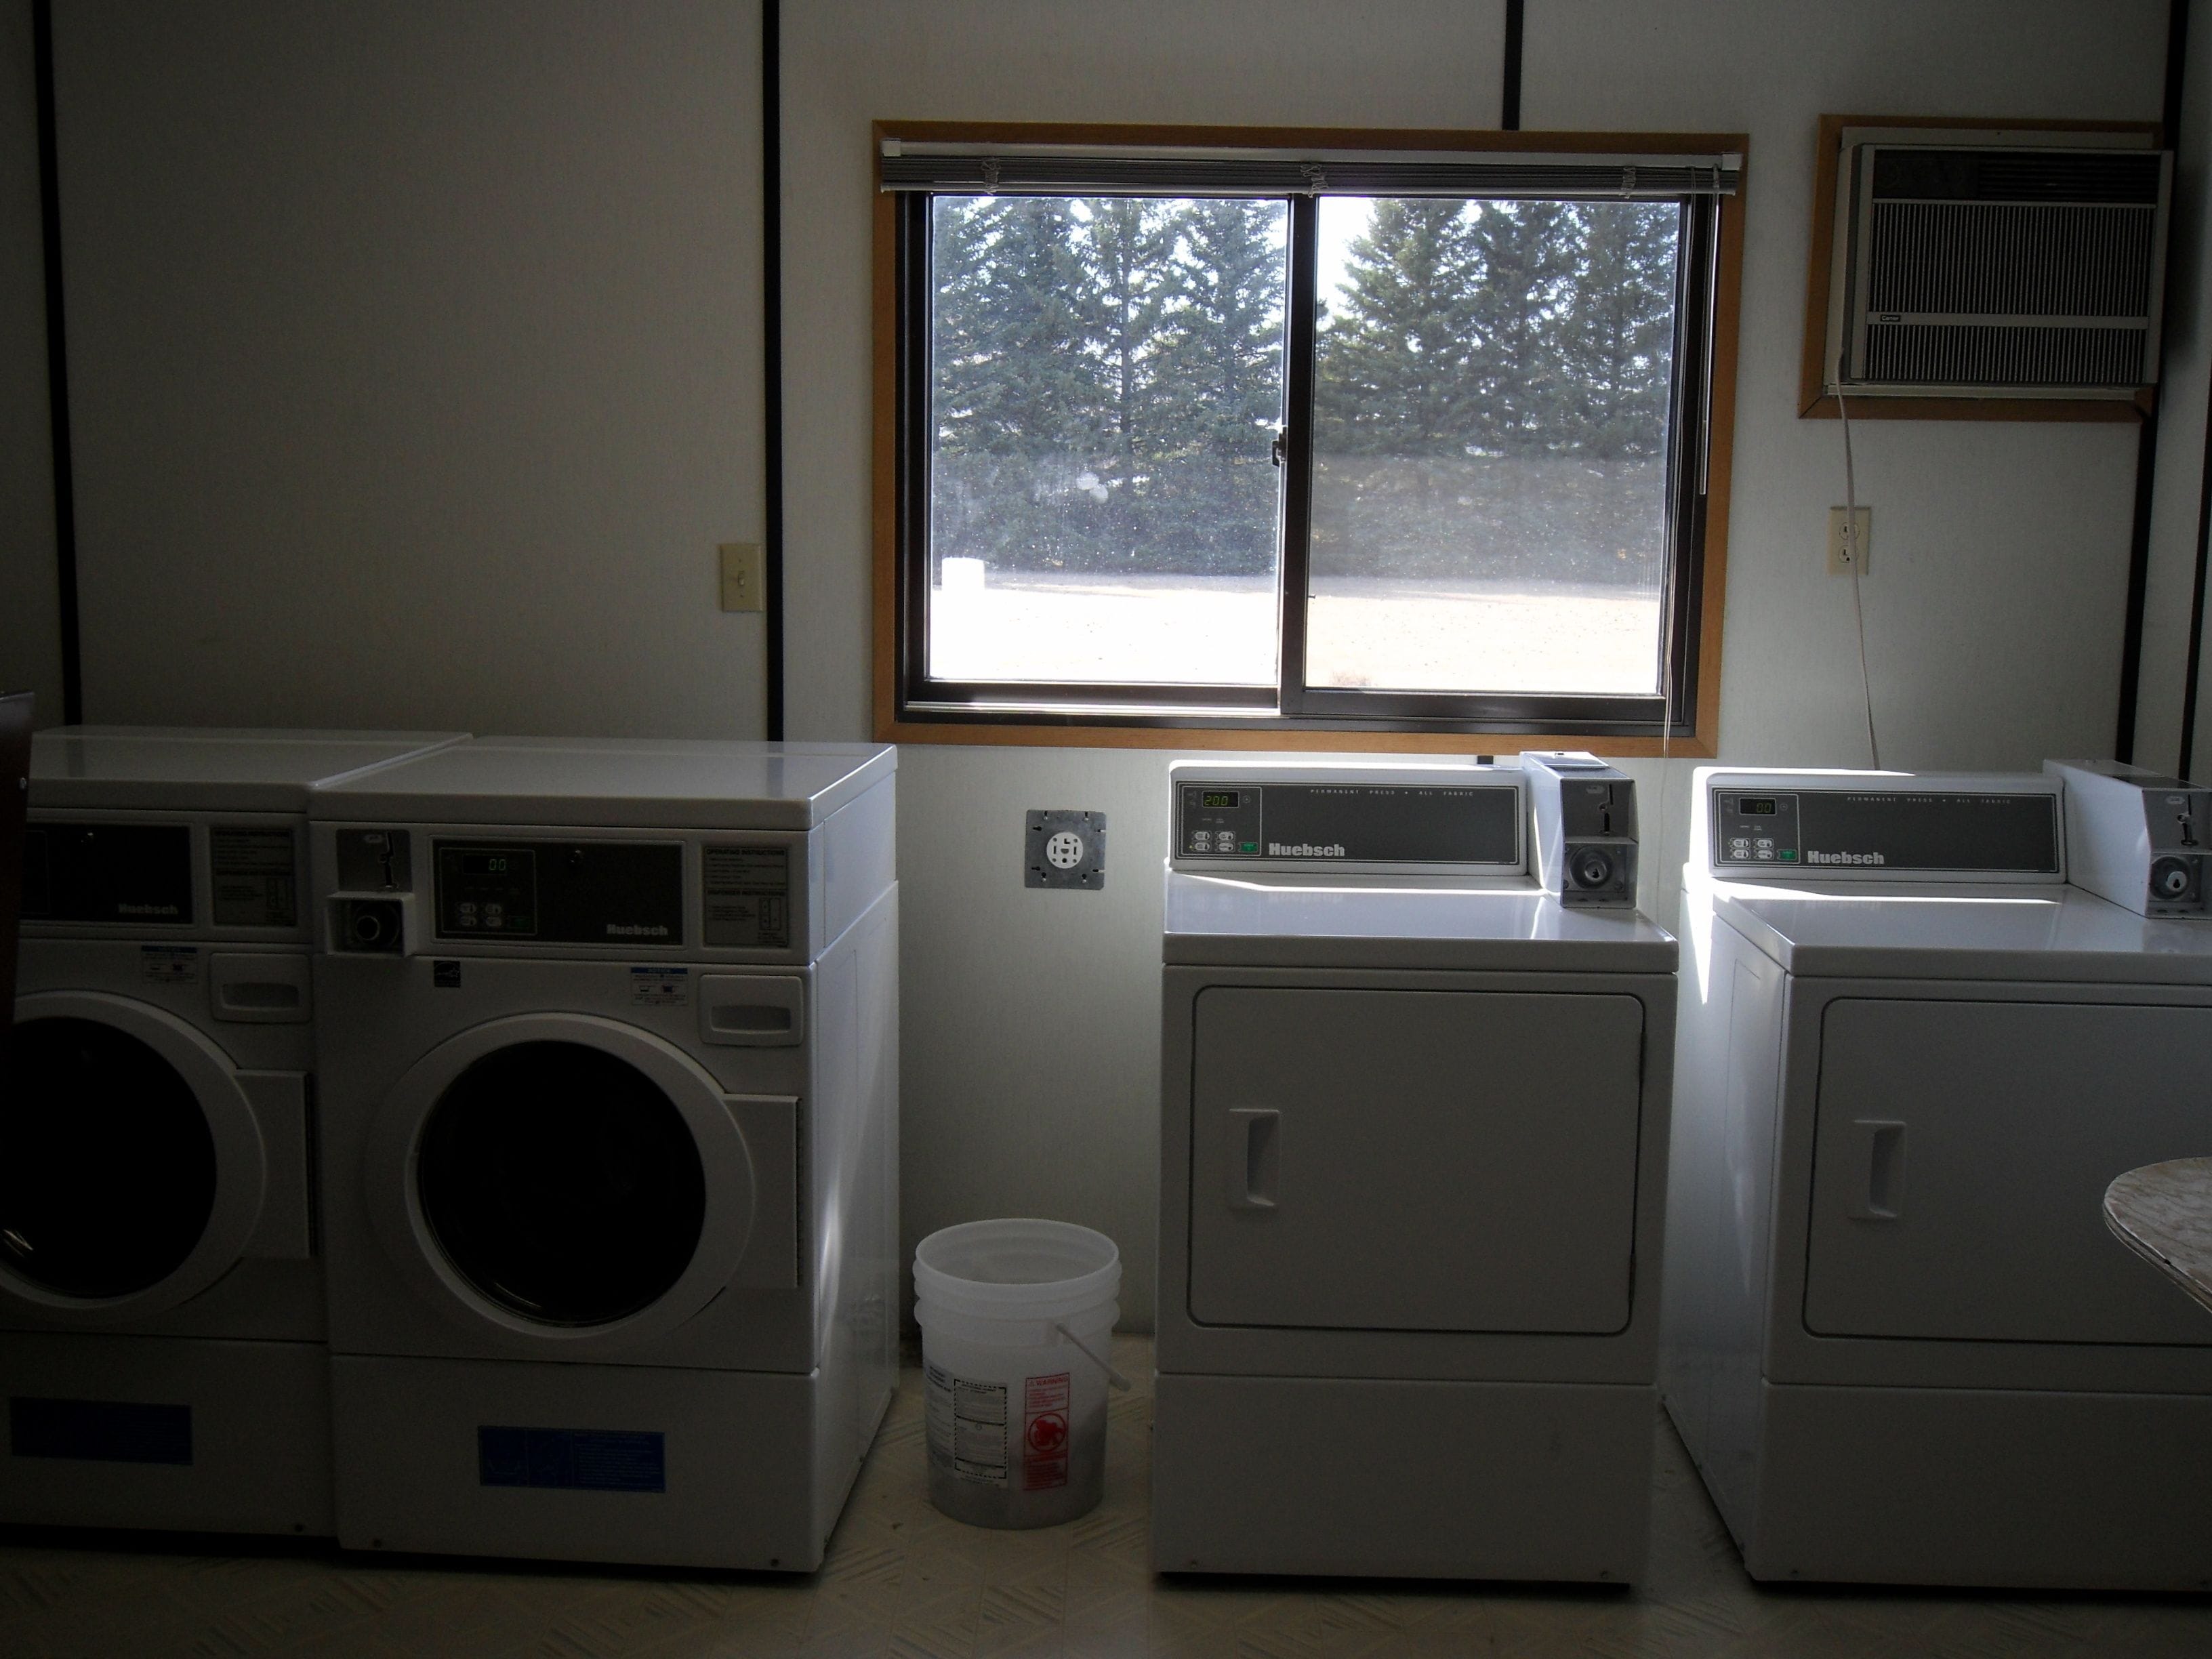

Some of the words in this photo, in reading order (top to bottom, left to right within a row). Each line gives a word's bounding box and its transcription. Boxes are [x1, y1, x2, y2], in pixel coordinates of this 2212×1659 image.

[1268, 842, 1345, 857] Huebsch
[1807, 850, 1885, 865] Huebsch
[606, 923, 669, 937] Huebsch
